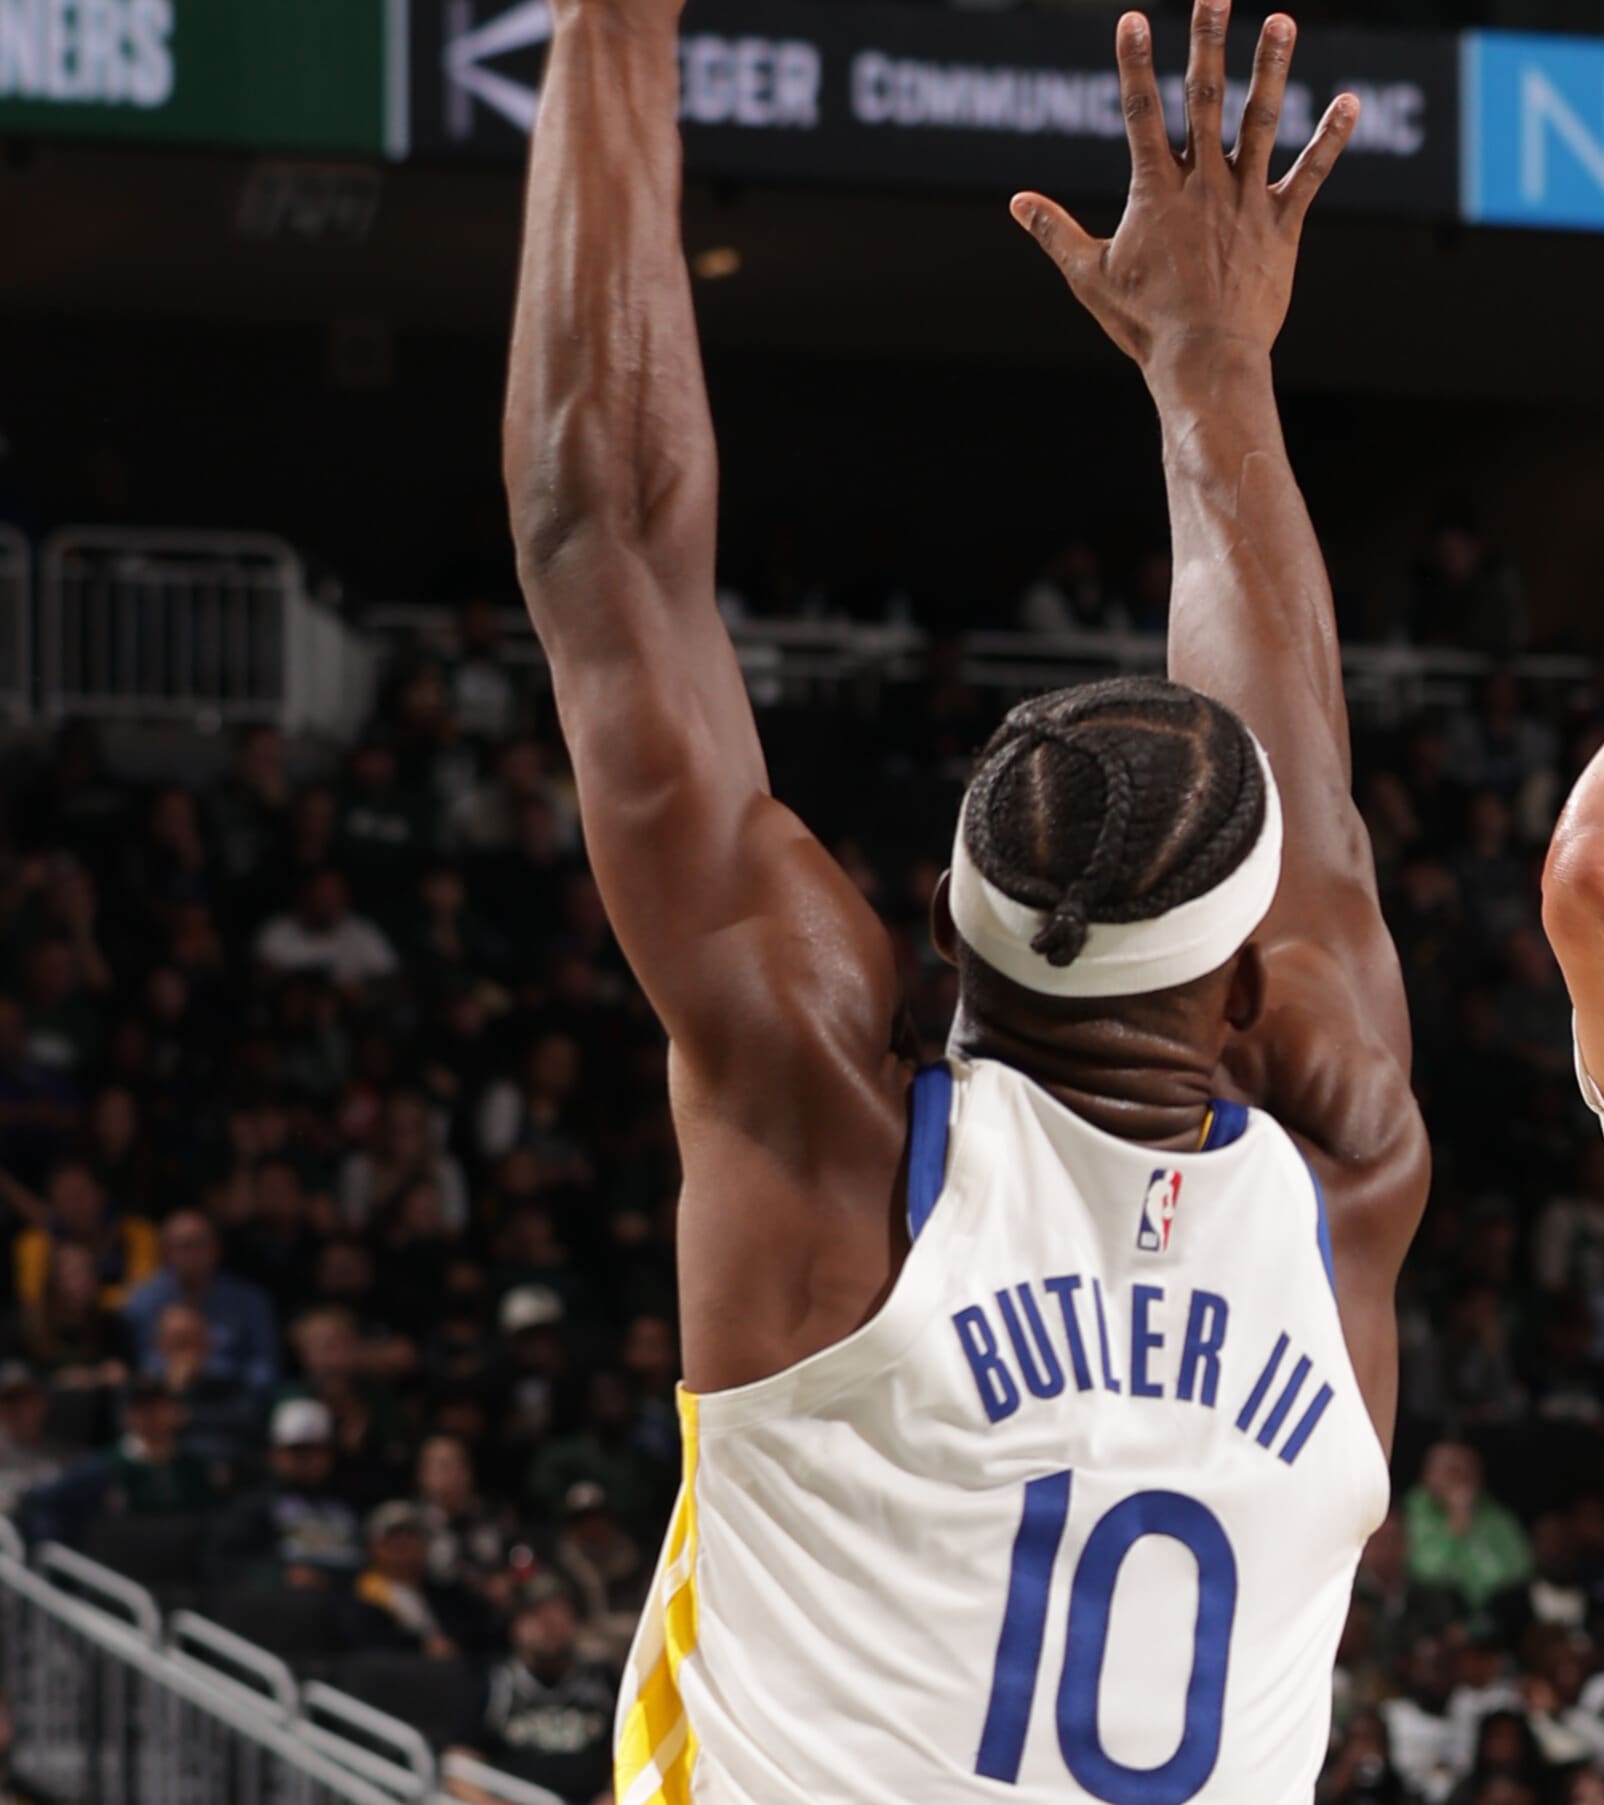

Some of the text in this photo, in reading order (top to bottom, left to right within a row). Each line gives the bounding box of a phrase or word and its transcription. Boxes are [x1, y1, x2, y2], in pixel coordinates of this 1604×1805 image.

[680, 33, 820, 130] GER
[1334, 80, 1426, 155] NC
[951, 1273, 1335, 1466] BUTLER III
[974, 1468, 1238, 1805] 10
